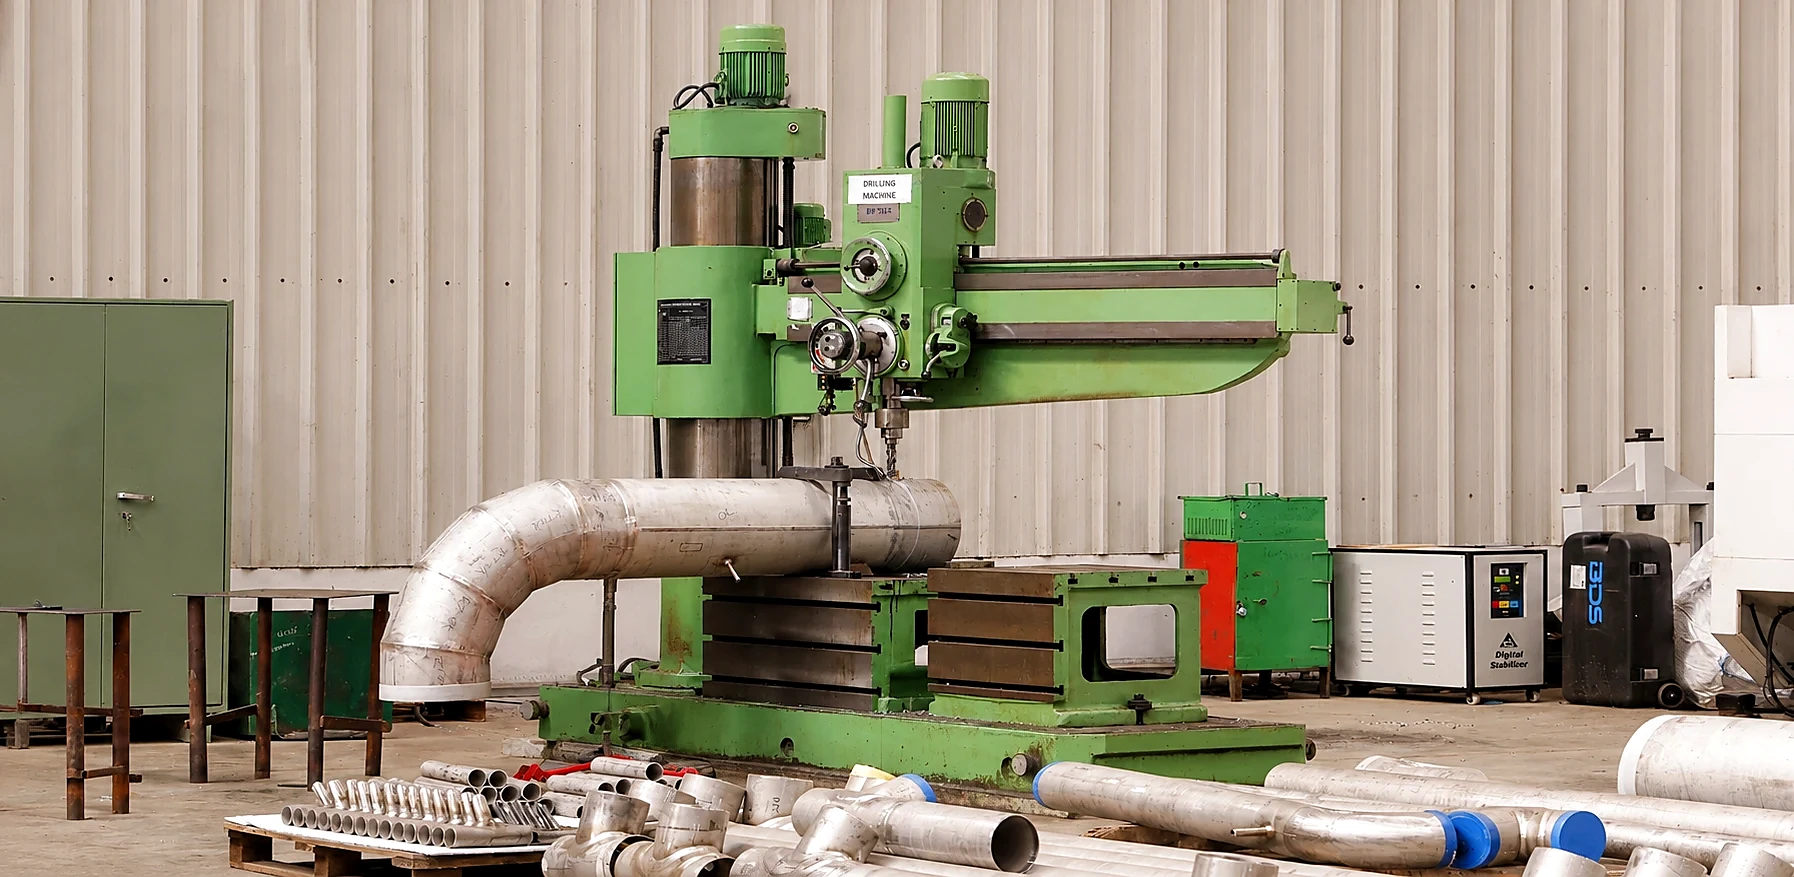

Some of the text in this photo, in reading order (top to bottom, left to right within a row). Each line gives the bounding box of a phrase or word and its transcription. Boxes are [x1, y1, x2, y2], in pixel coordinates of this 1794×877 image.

[862, 191, 897, 199] MACHINE
[1588, 561, 1603, 625] BDS
[1495, 650, 1524, 660] Digital
